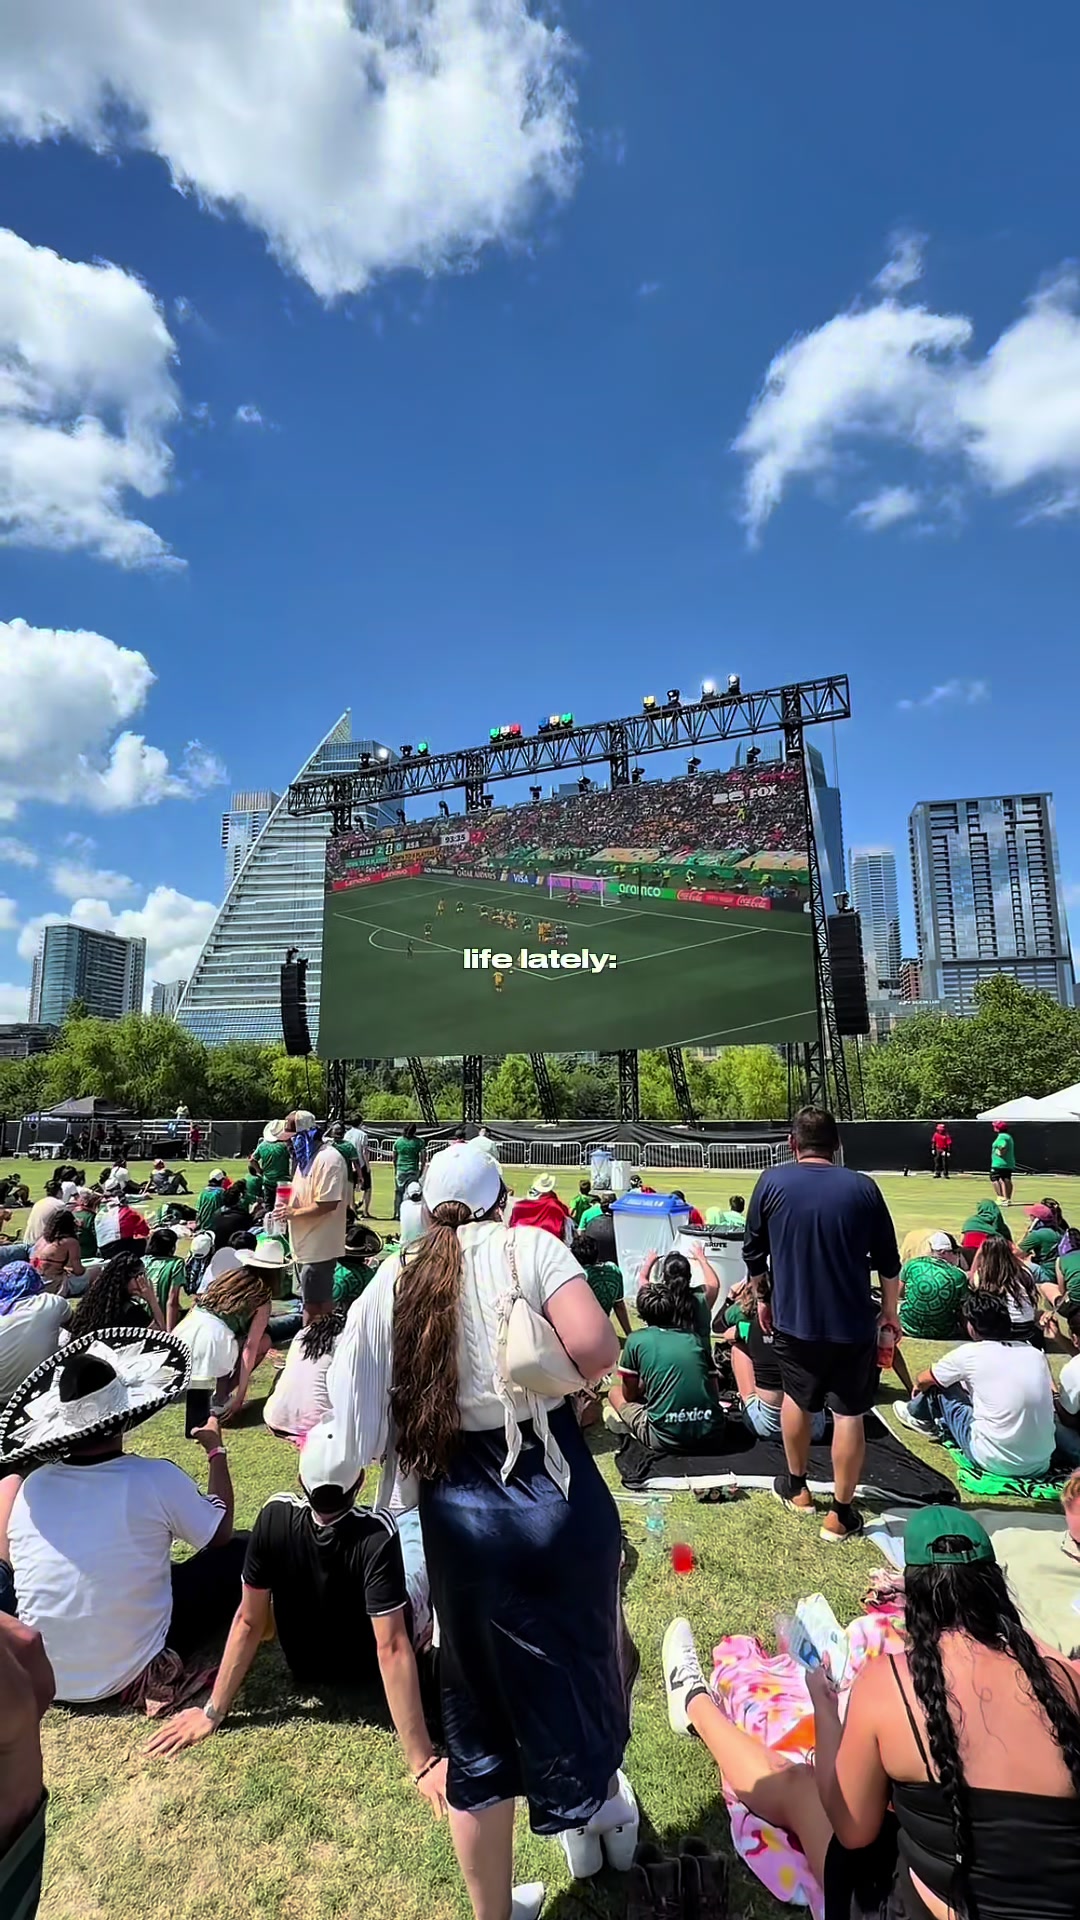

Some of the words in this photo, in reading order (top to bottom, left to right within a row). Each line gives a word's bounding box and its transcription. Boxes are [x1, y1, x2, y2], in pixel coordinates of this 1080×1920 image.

[749, 785, 778, 799] FOX
[444, 834, 466, 844] 93:35
[381, 868, 408, 879] Lenovo
[512, 873, 529, 884] VISA
[344, 876, 371, 887] Lenovo
[664, 1407, 712, 1423] méxico
